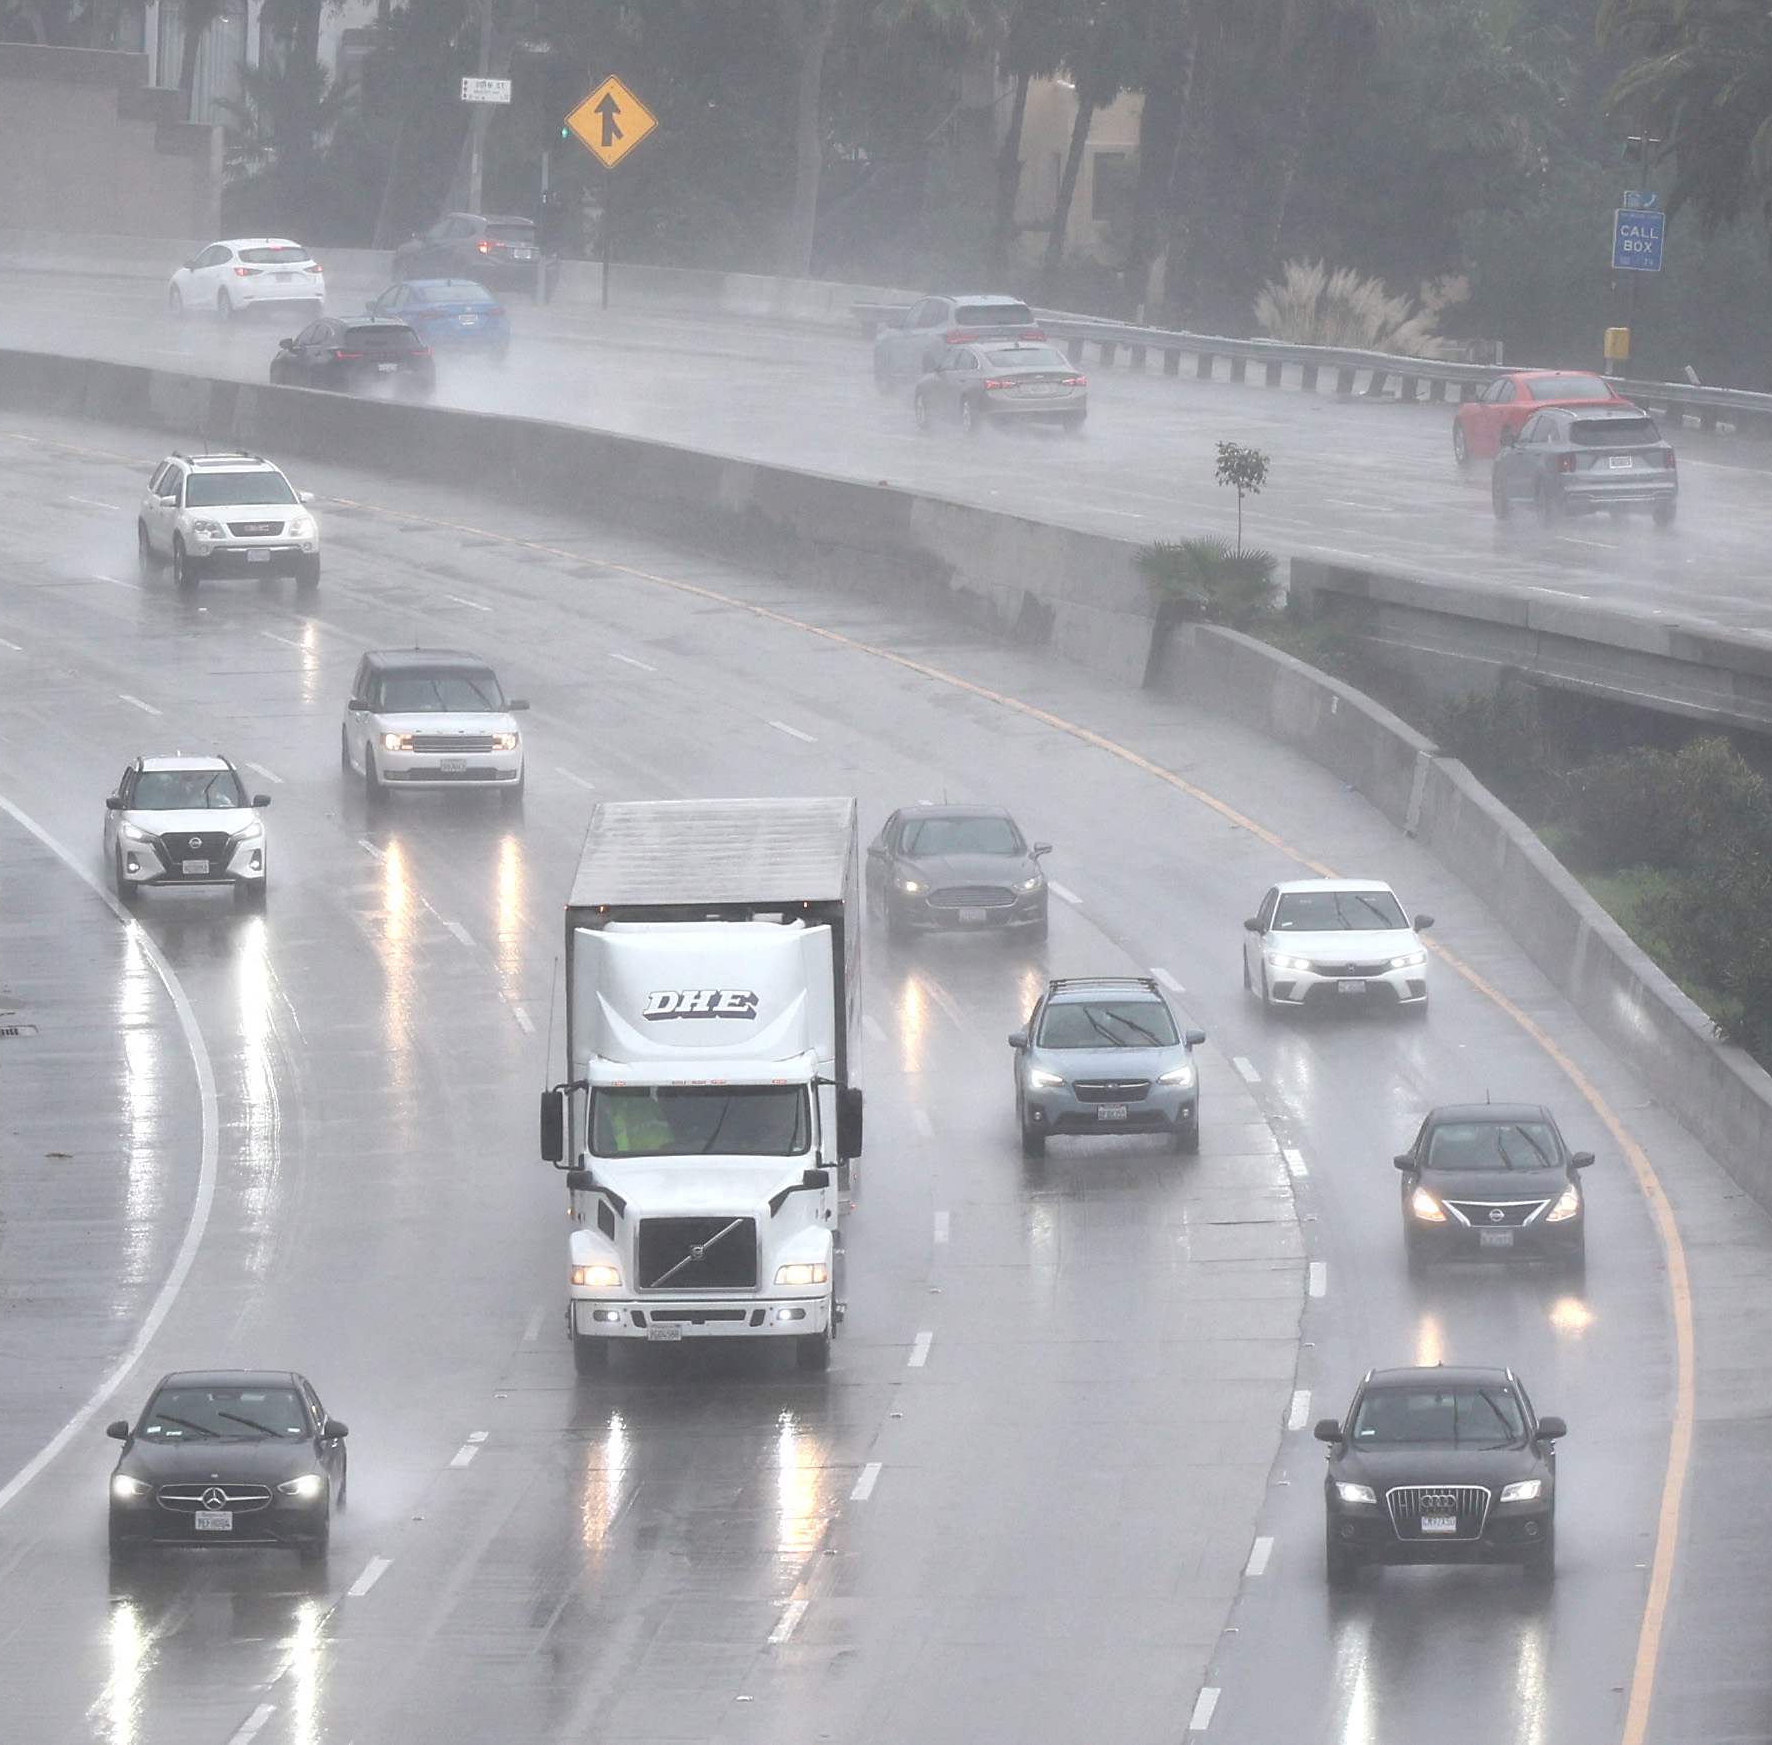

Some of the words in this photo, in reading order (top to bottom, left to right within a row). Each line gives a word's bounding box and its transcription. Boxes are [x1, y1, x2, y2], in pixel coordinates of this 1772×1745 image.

[1620, 225, 1659, 240] CALL
[1623, 240, 1652, 253] BOX
[642, 989, 760, 1021] DHE
